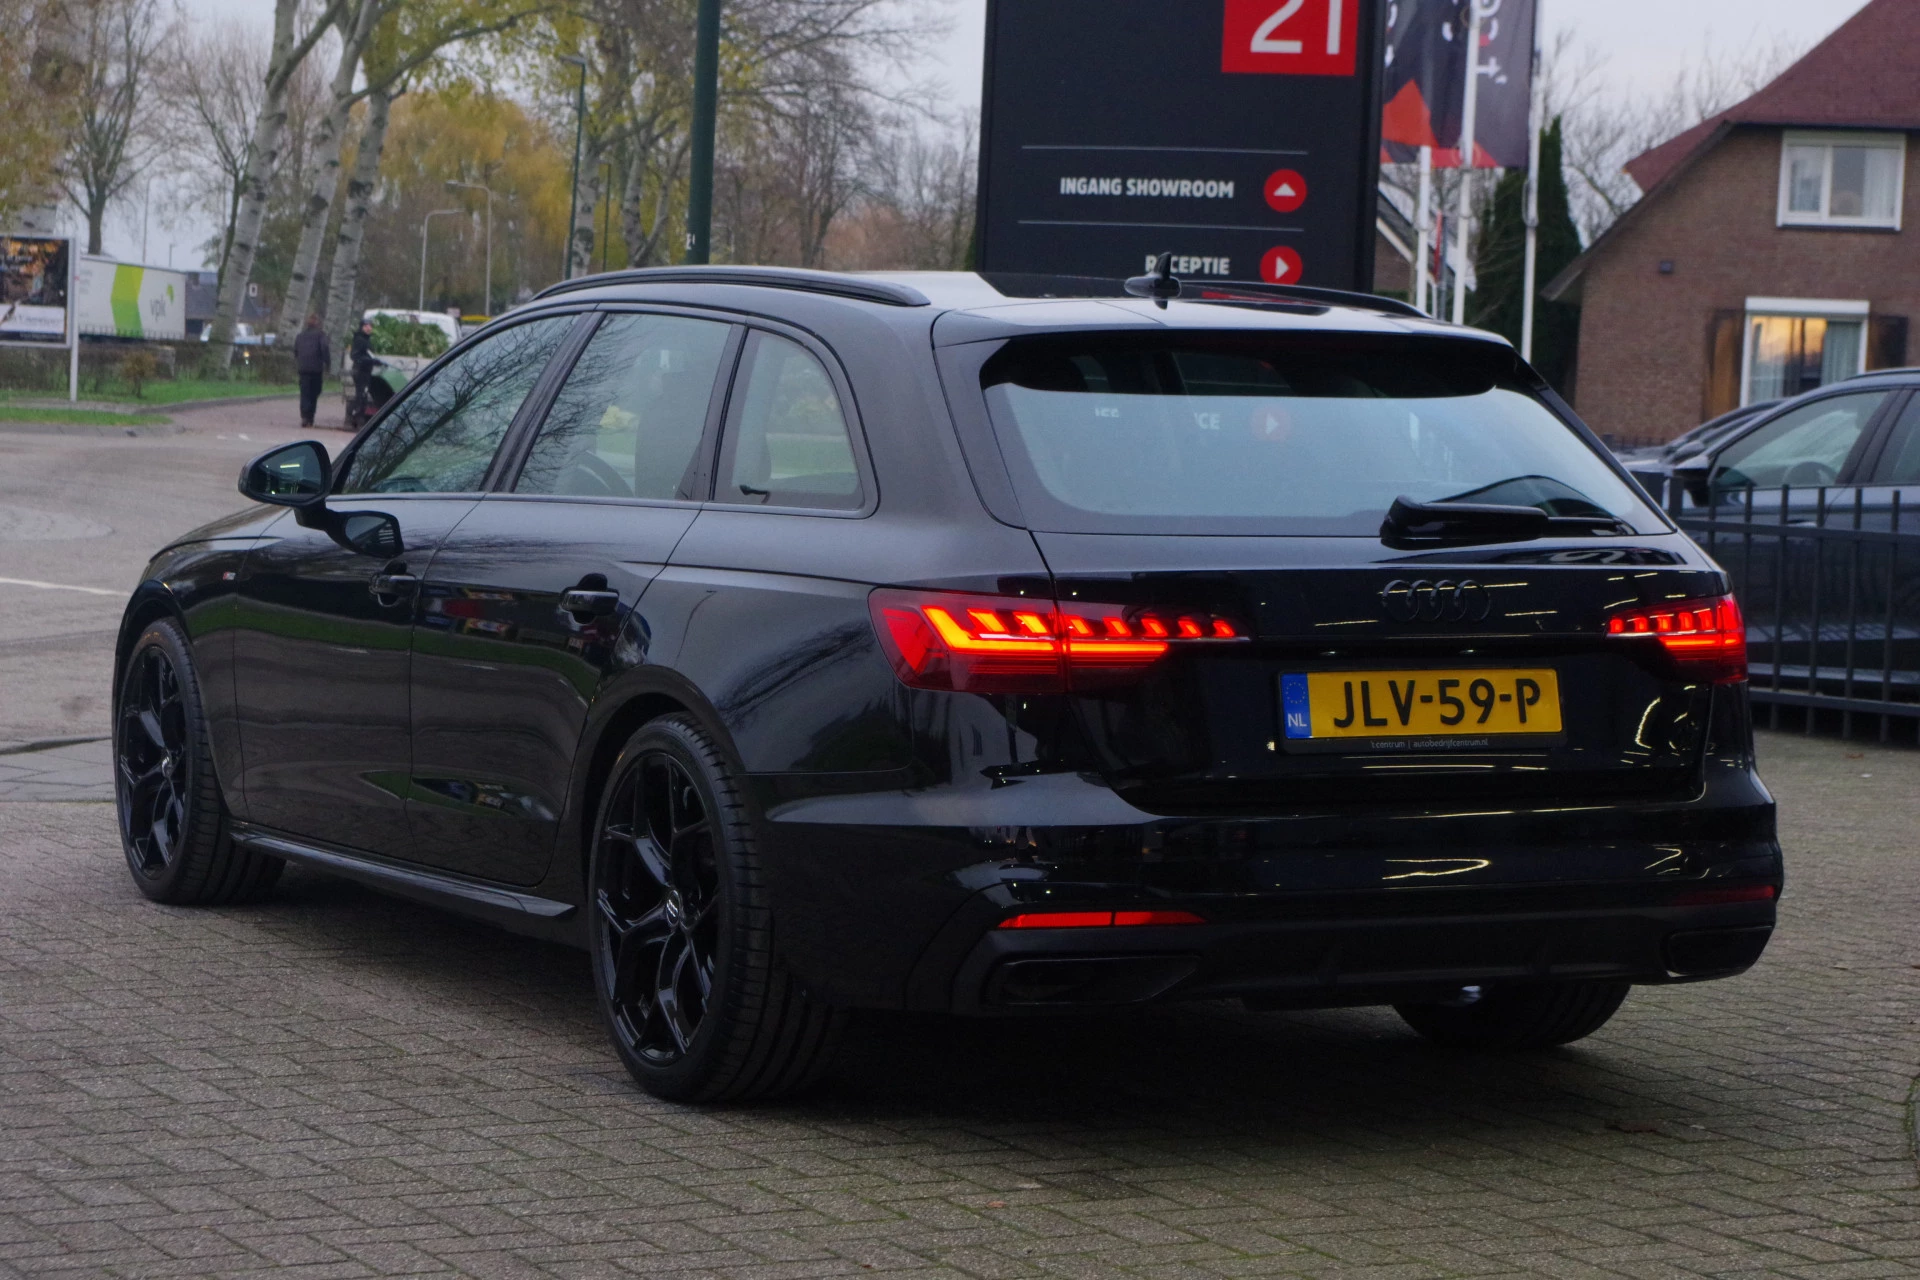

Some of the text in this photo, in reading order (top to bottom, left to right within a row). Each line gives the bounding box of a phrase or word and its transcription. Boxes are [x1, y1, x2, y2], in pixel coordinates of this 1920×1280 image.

[1060, 177, 1235, 198] INGANG SHOWROOM
[1145, 255, 1230, 275] RCEPTIE
[1333, 678, 1541, 728] JLV-59-P
[1287, 713, 1307, 728] NL
[1376, 740, 1405, 748] centrum
[1413, 738, 1488, 748] autobedrijfcentrum.nl
